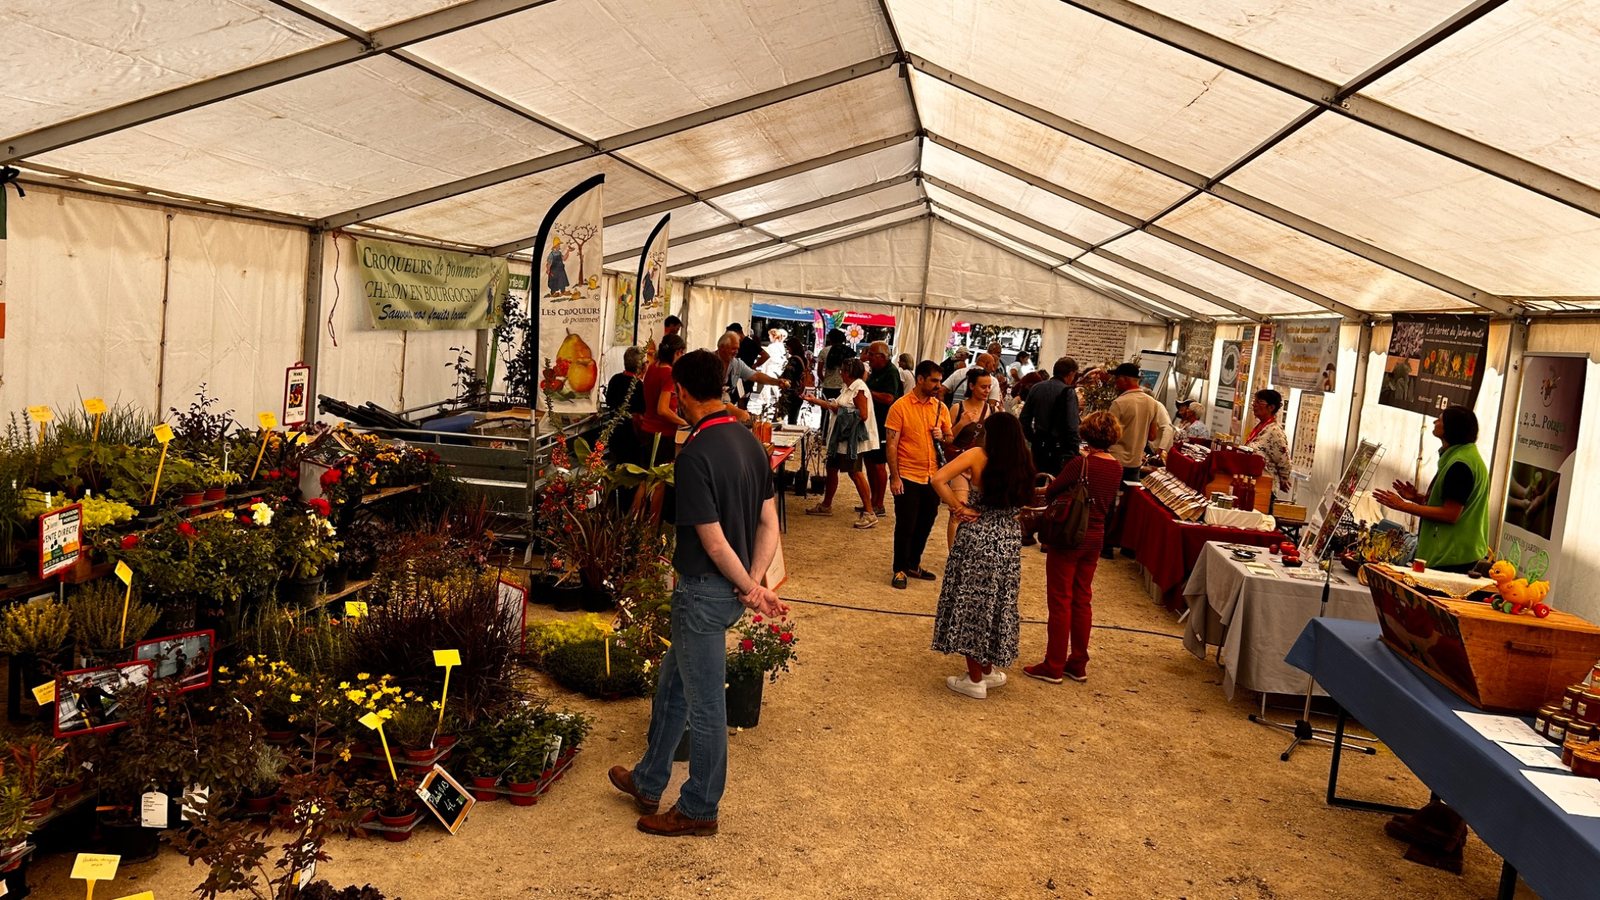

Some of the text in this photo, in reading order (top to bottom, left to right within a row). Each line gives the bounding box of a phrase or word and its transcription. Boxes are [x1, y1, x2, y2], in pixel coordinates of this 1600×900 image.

[363, 246, 480, 283] CROQUEURS de pommes
[365, 280, 478, 303] CHALON EN BOURGOGNE
[541, 307, 600, 316] LES CROQUEURS
